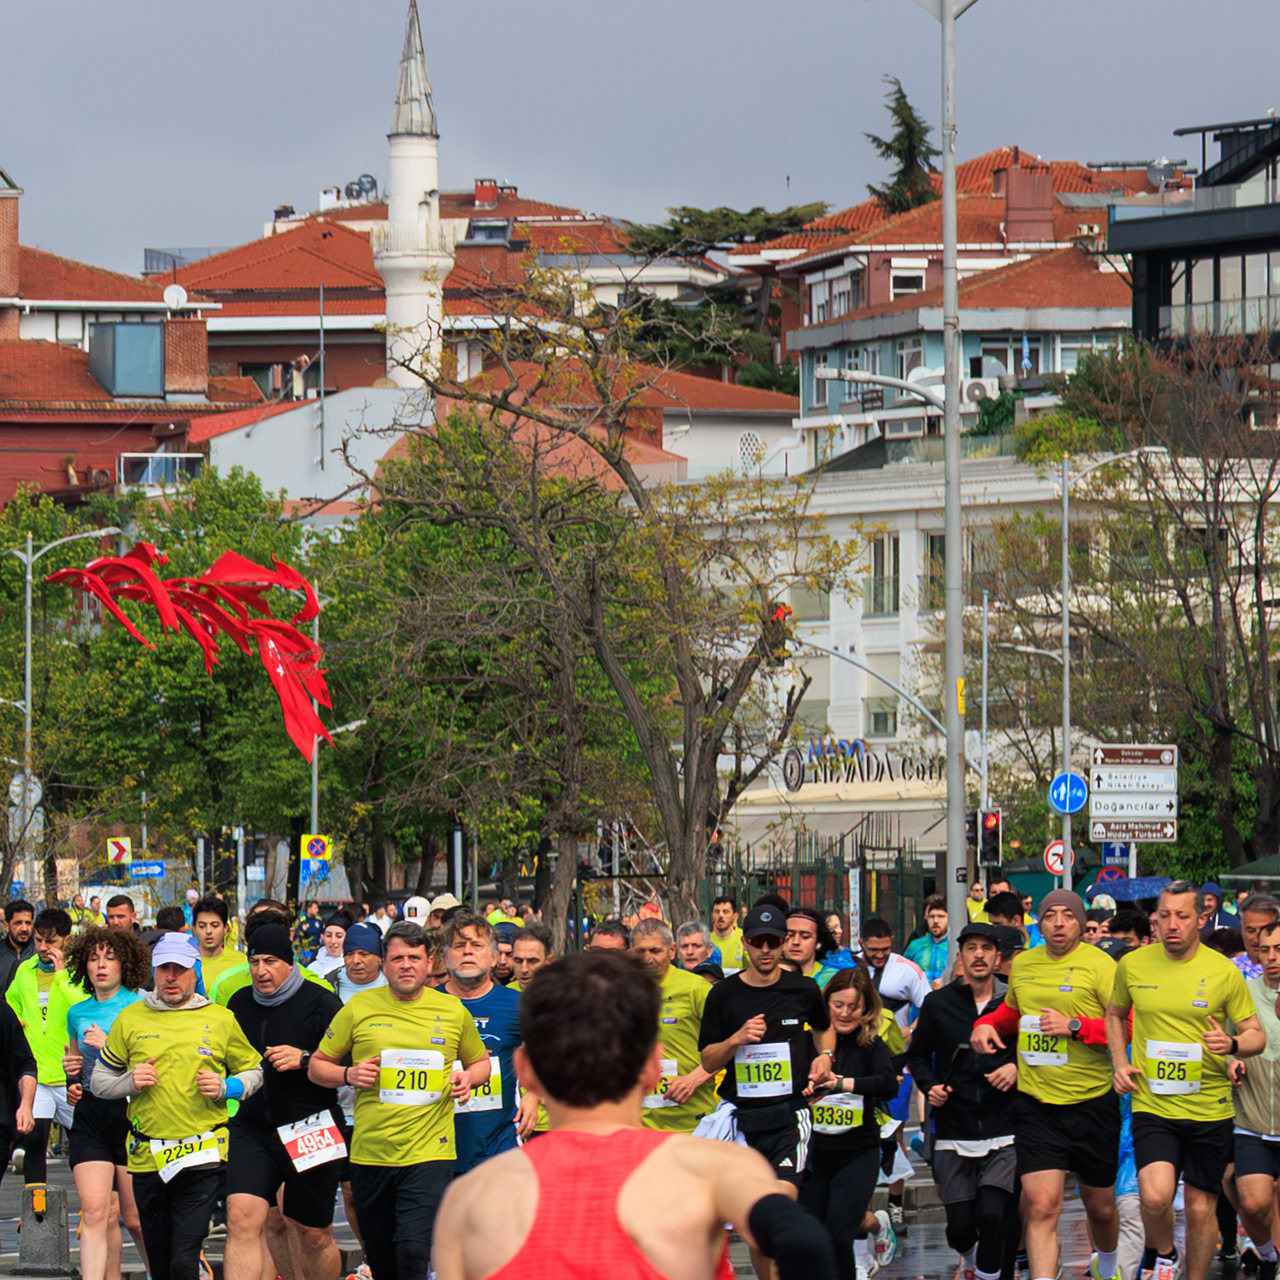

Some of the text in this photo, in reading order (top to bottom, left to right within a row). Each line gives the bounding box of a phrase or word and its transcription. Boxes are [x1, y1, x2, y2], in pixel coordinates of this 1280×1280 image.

[1094, 801, 1159, 812] Doğancılar
[1027, 1034, 1058, 1052] 1352
[396, 1070, 428, 1090] 210
[745, 1062, 782, 1082] 1162
[1157, 1061, 1186, 1081] 625
[816, 1106, 854, 1126] 3339
[163, 1141, 204, 1164] 2297
[296, 1129, 334, 1156] 4954
